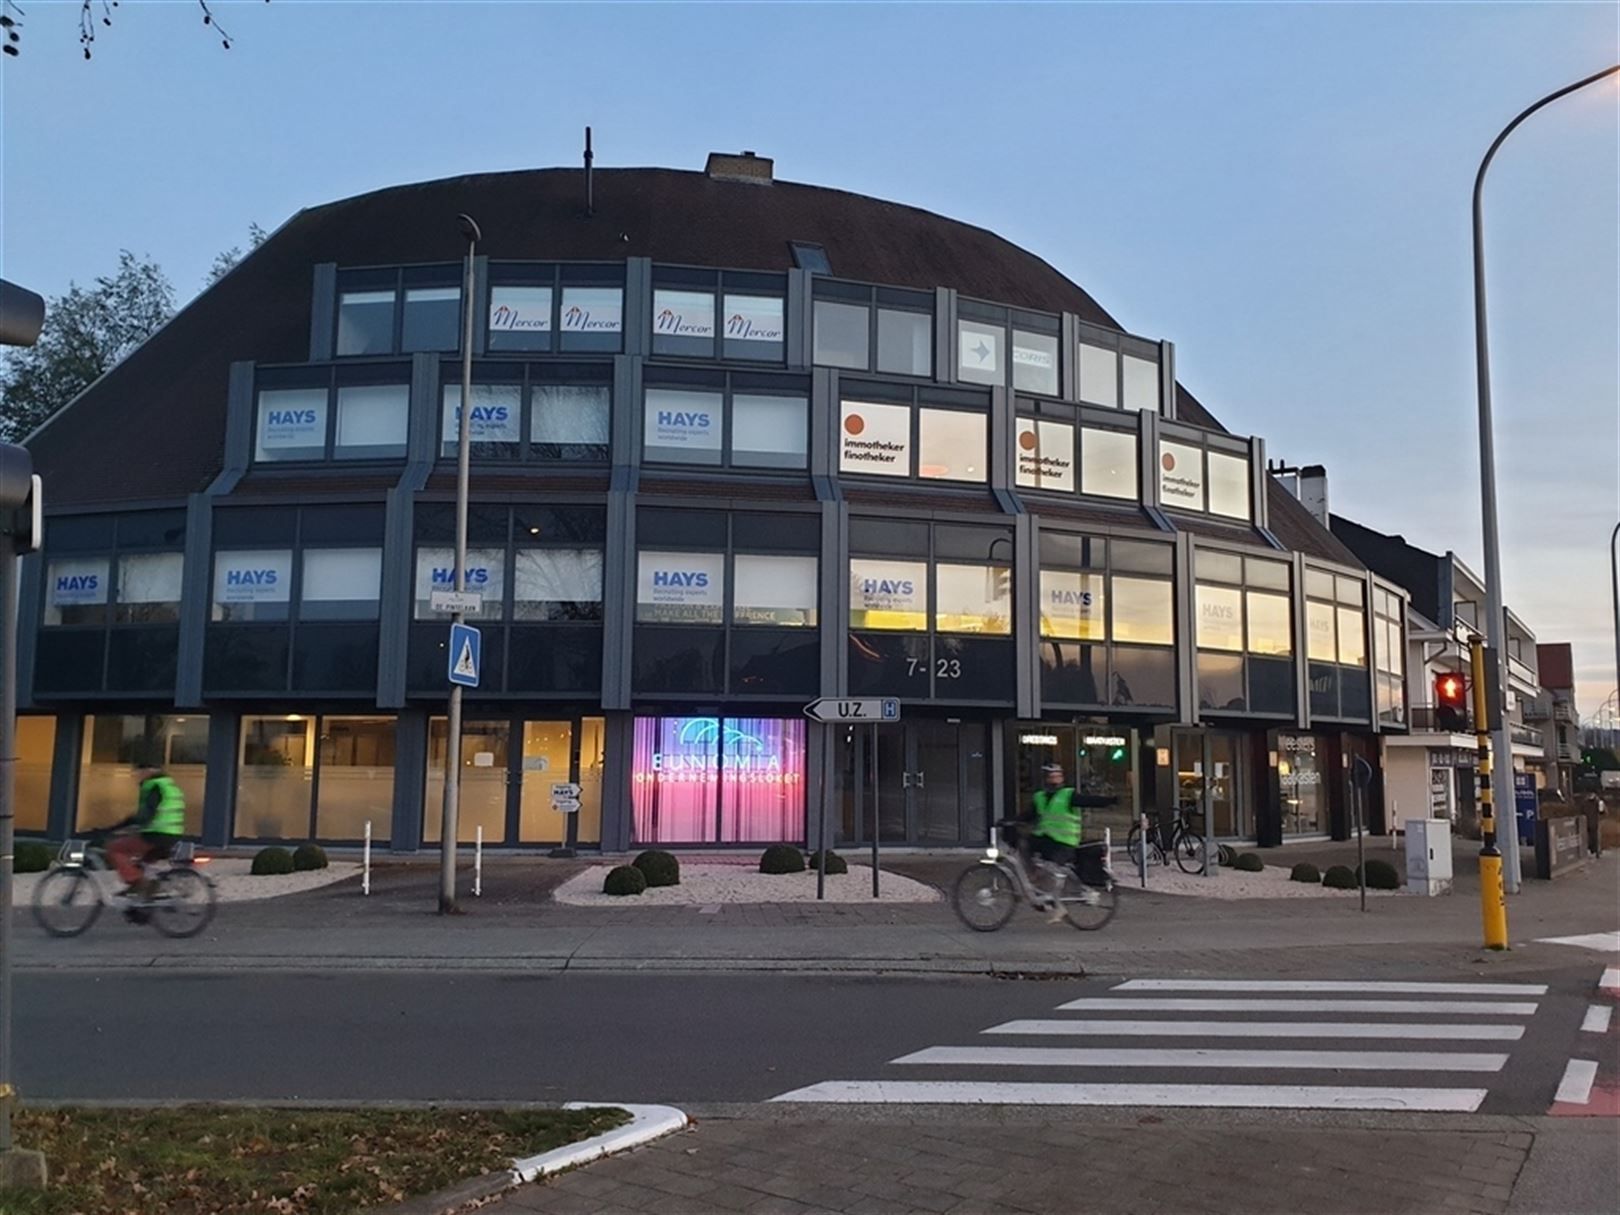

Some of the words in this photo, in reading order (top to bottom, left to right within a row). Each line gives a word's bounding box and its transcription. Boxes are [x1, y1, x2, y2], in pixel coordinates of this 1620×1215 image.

[494, 305, 548, 329] Mercor
[565, 306, 620, 330] Mercor
[657, 309, 712, 334] Mercor
[728, 314, 781, 338] Mercor
[268, 409, 316, 425] HAYS
[658, 411, 710, 427] HAYS
[844, 438, 905, 451] immotheker
[844, 450, 896, 462] finotheker
[57, 575, 98, 590] HAYS
[227, 570, 277, 584] HAYS
[432, 568, 488, 583] HAYS
[654, 571, 709, 587] HAYS
[864, 579, 914, 595] HAYS
[1051, 590, 1091, 606] HAYS
[1202, 603, 1233, 619] HAYS
[838, 702, 867, 717] U.Z.
[653, 753, 780, 771] EUNOMIA
